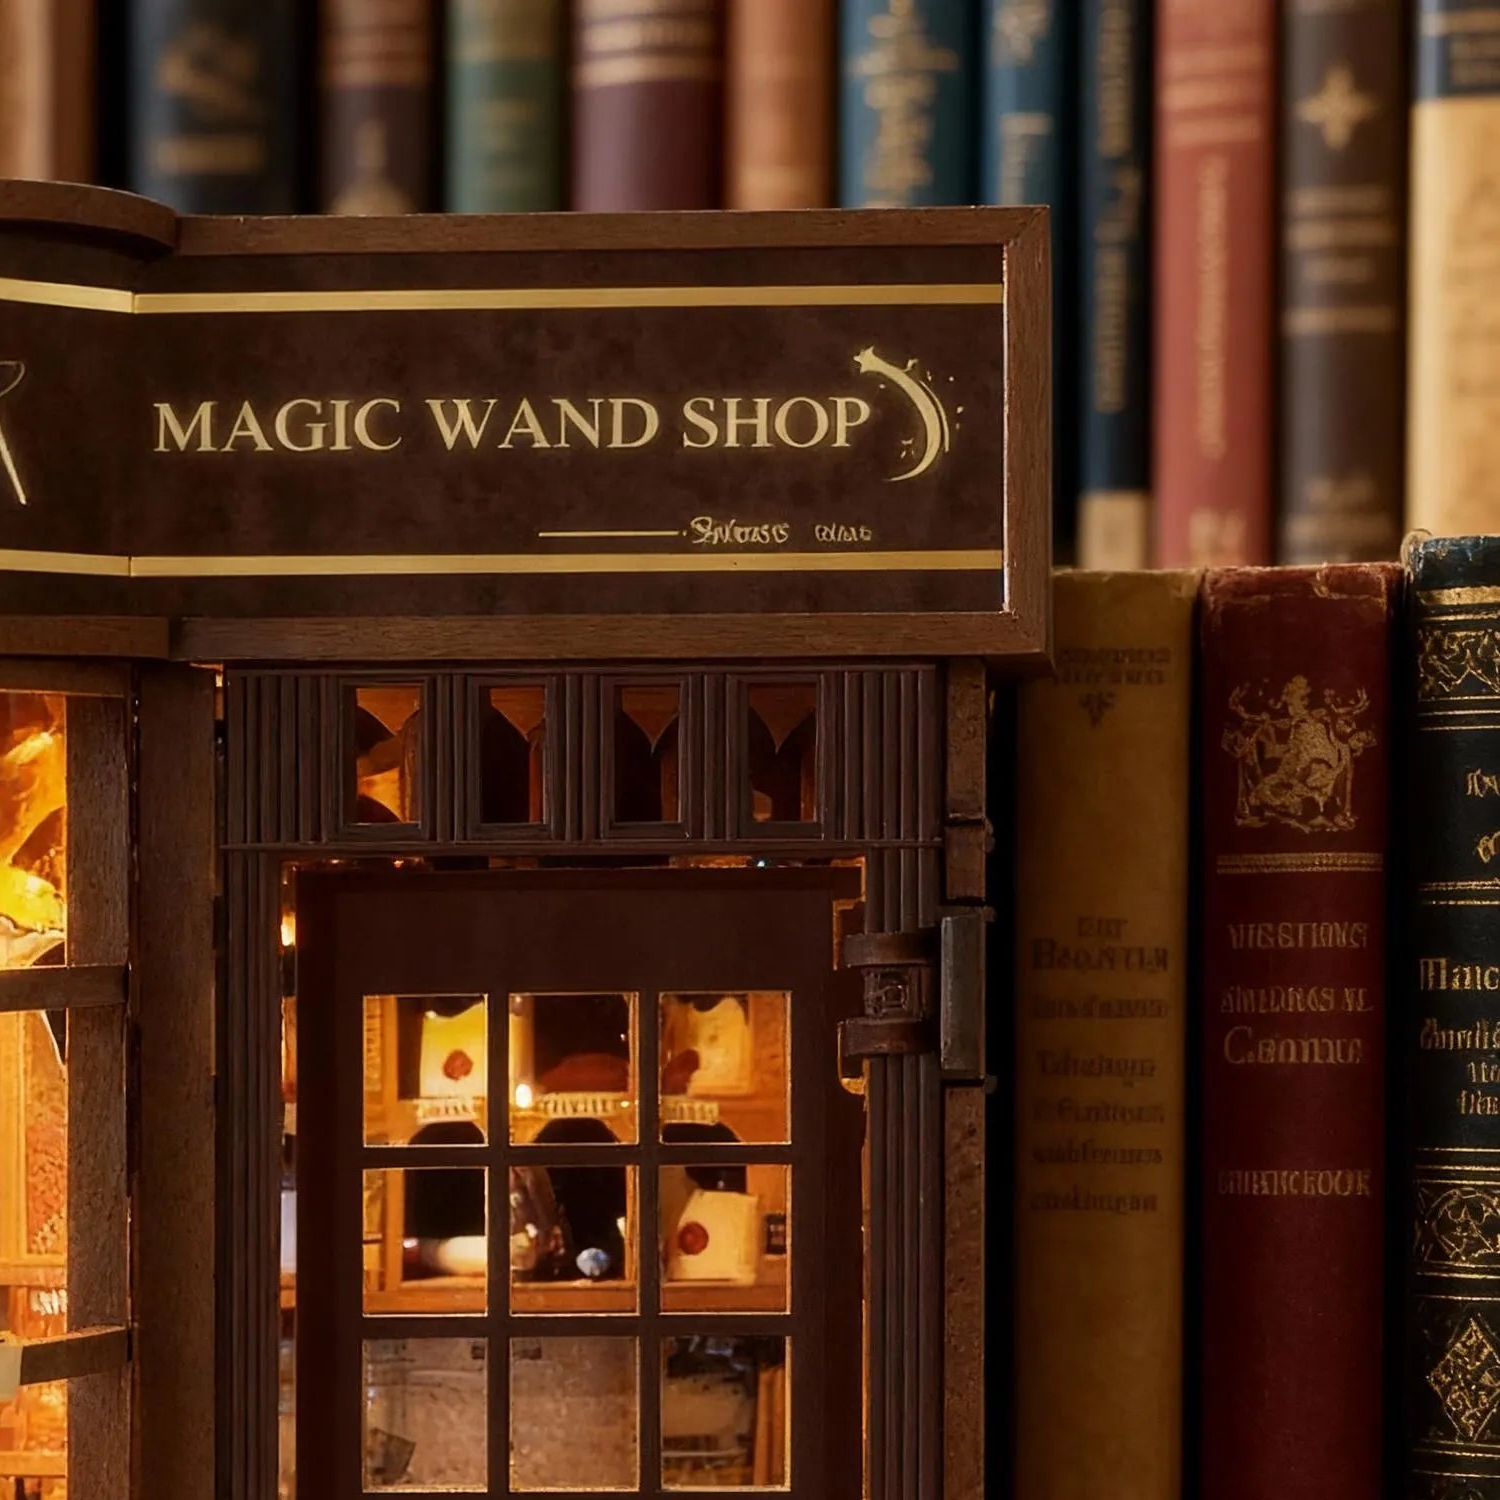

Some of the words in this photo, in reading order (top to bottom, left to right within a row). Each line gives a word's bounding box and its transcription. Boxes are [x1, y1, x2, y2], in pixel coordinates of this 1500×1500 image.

[153, 398, 403, 453] MAGIC
[425, 397, 660, 452] WAND
[682, 396, 872, 450] SHOP
